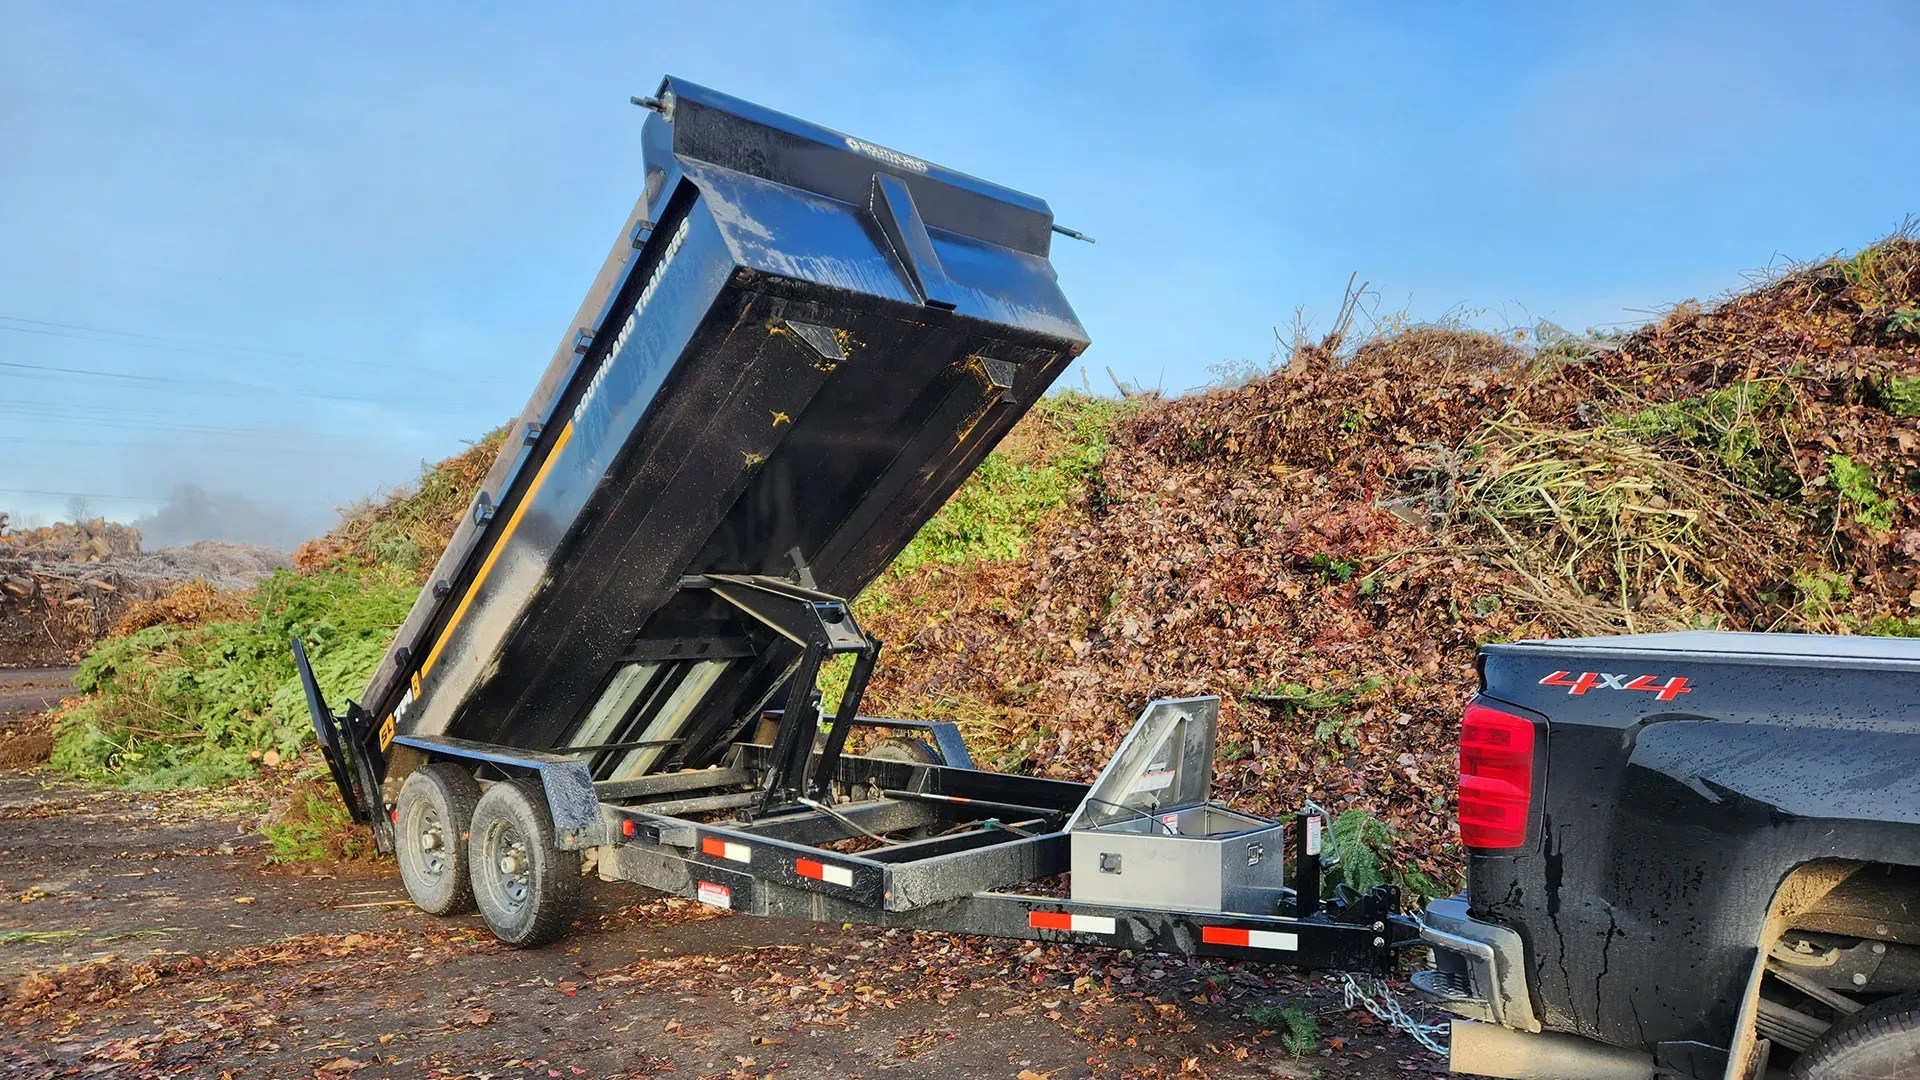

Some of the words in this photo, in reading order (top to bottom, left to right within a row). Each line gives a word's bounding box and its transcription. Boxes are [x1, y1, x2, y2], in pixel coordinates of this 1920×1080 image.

[859, 142, 928, 172] SOUTHLAND
[574, 314, 635, 423] SOUTHLAND
[635, 216, 690, 316] TRAILERS
